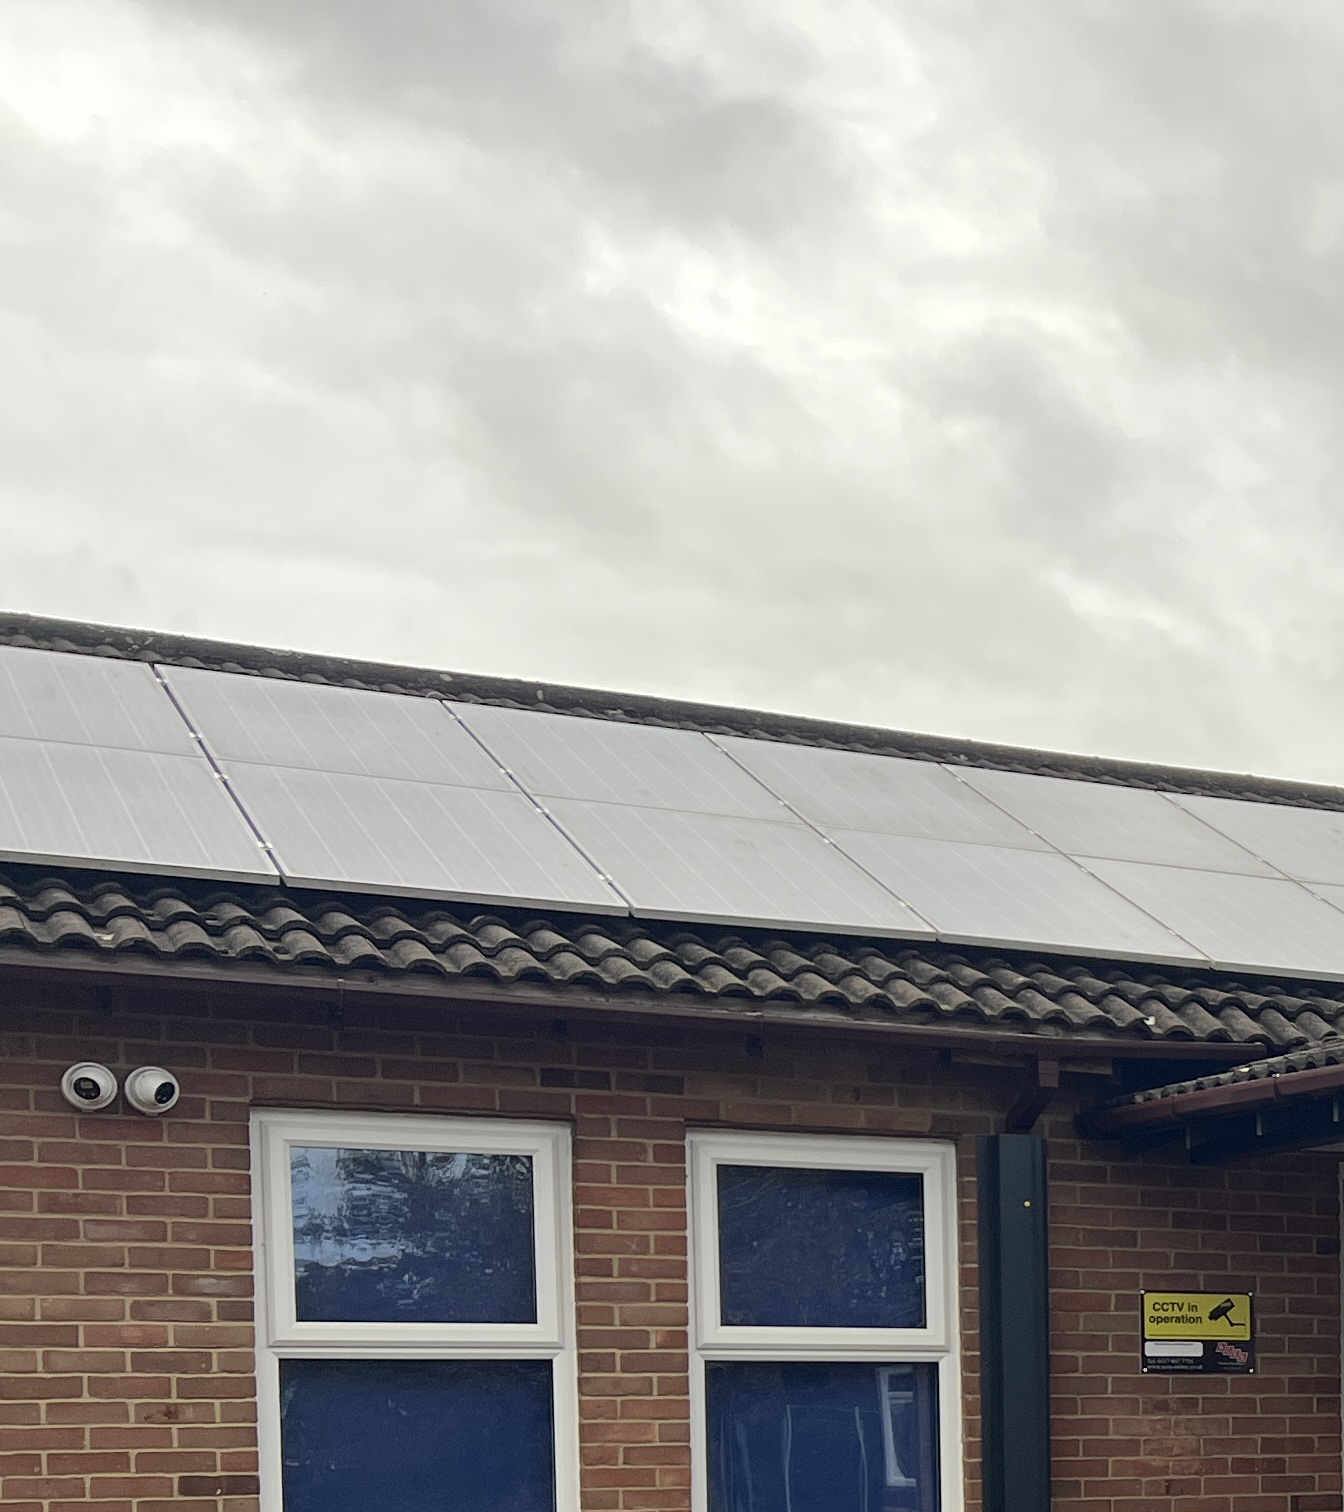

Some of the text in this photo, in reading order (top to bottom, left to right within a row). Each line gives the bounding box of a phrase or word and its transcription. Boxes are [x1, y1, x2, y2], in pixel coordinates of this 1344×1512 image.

[1152, 1301, 1199, 1312] CCTV in
[1148, 1314, 1203, 1325] operation
